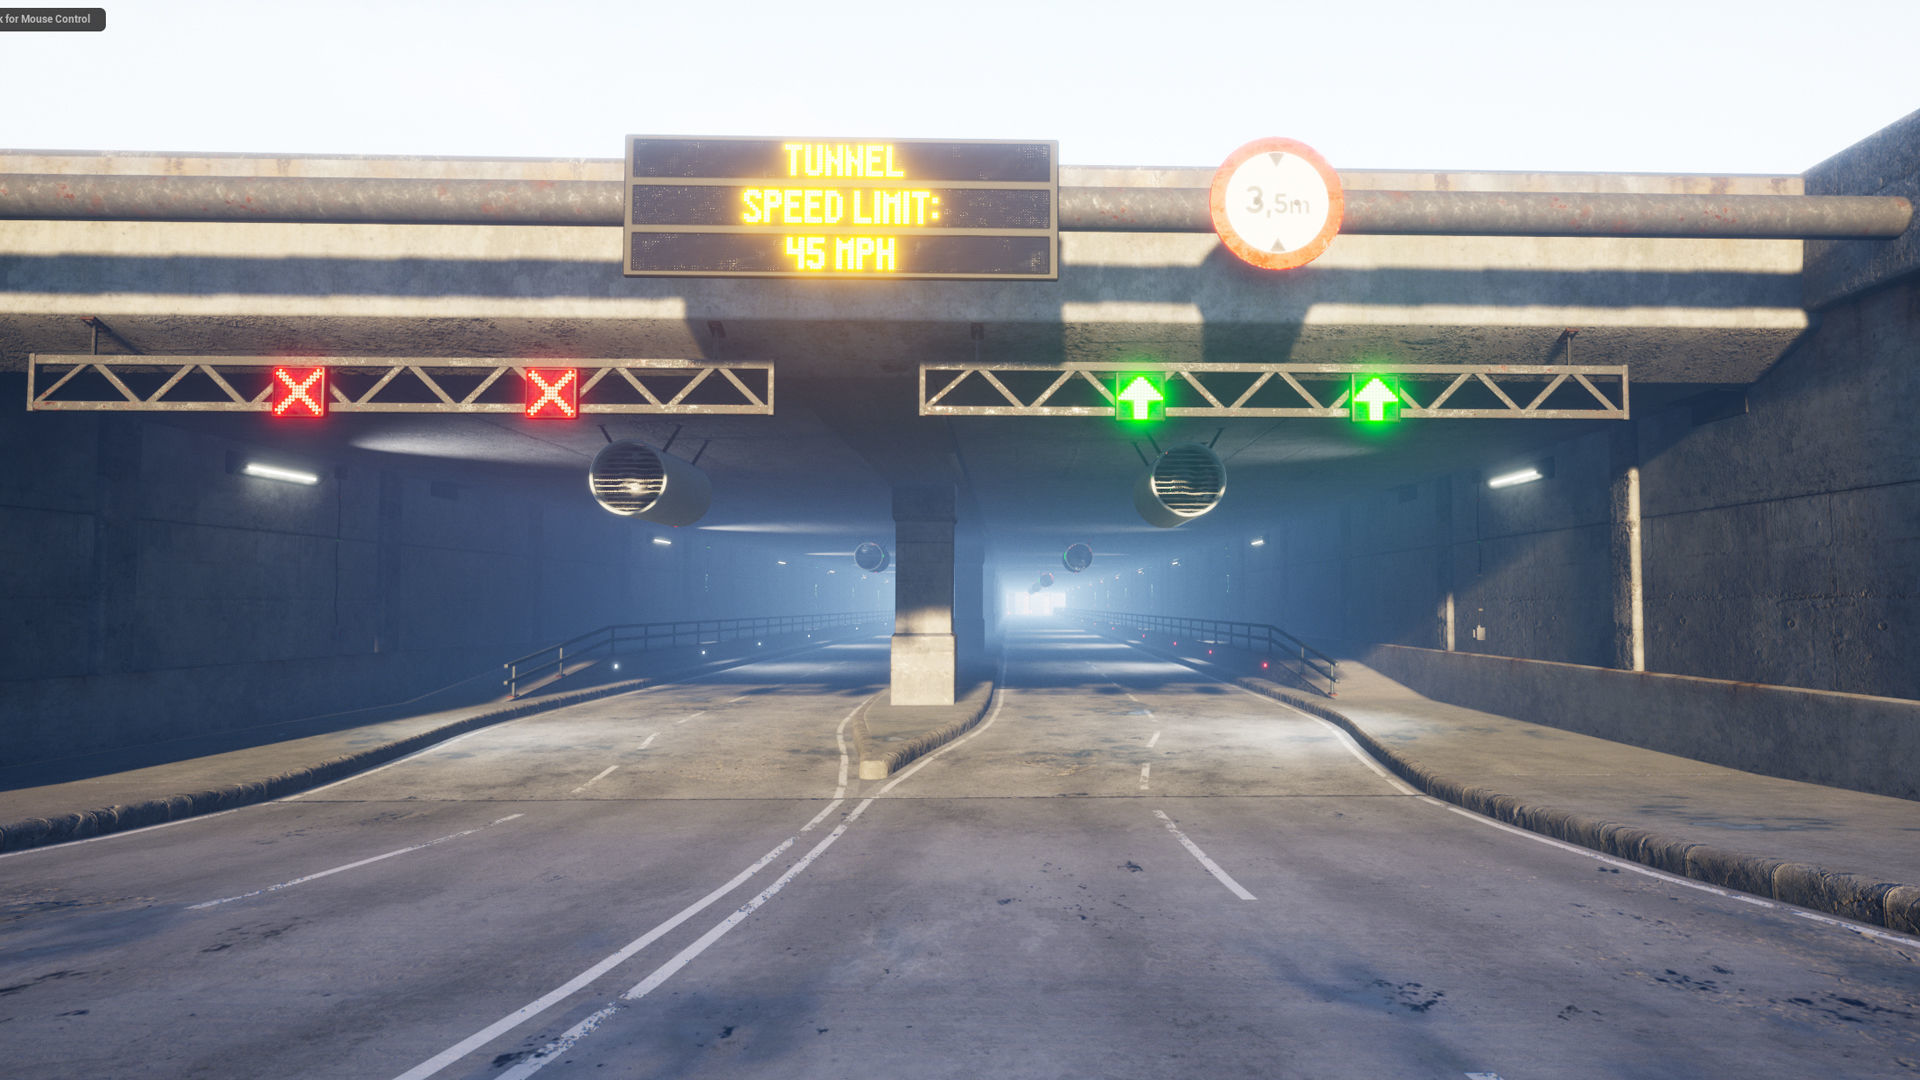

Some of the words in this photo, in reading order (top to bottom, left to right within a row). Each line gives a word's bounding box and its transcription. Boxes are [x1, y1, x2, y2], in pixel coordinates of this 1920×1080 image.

[783, 143, 905, 178] TUNNEL
[741, 189, 844, 224] SPEED
[853, 190, 941, 225] LIMIT:
[785, 236, 827, 271] 45
[834, 237, 897, 272] MPH
